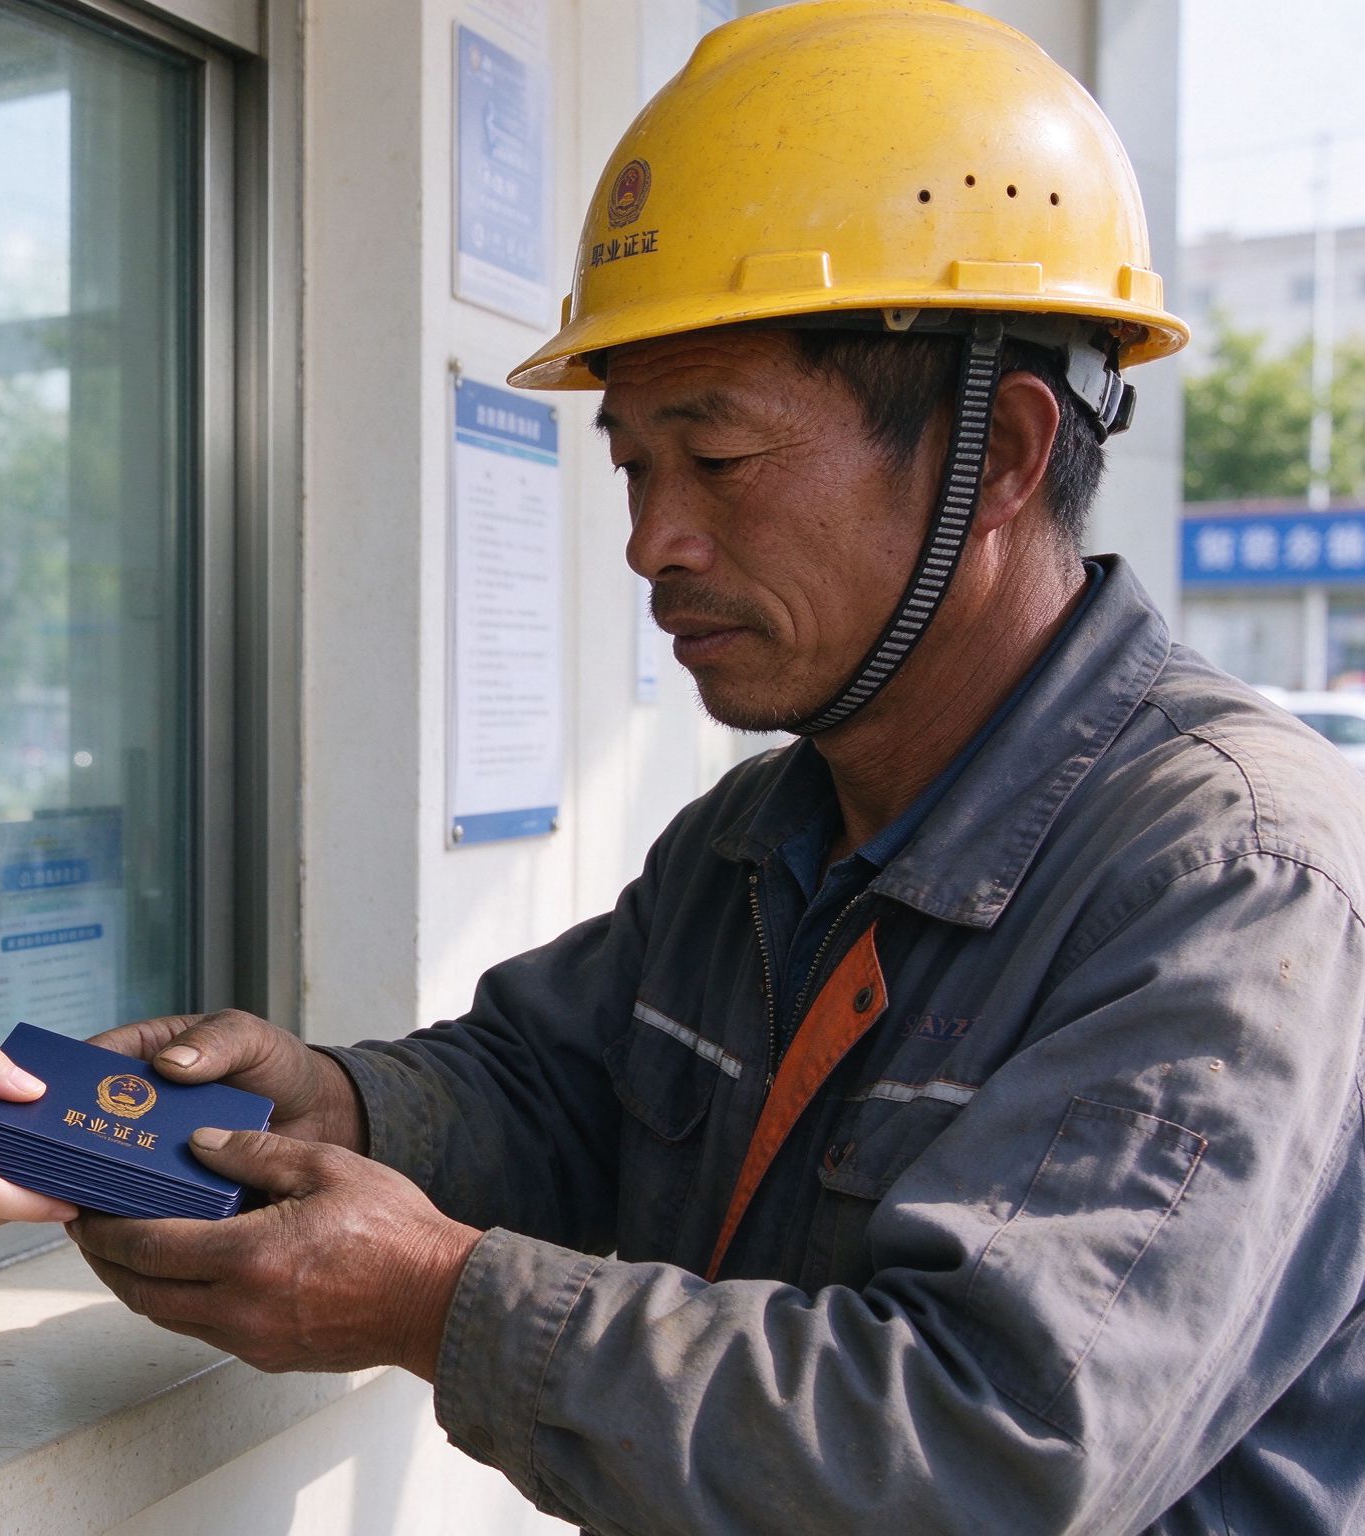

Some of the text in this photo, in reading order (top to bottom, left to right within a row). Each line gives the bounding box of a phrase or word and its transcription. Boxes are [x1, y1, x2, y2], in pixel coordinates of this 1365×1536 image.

[591, 230, 659, 267] 职业证证
[63, 1109, 159, 1150] 职业证证
